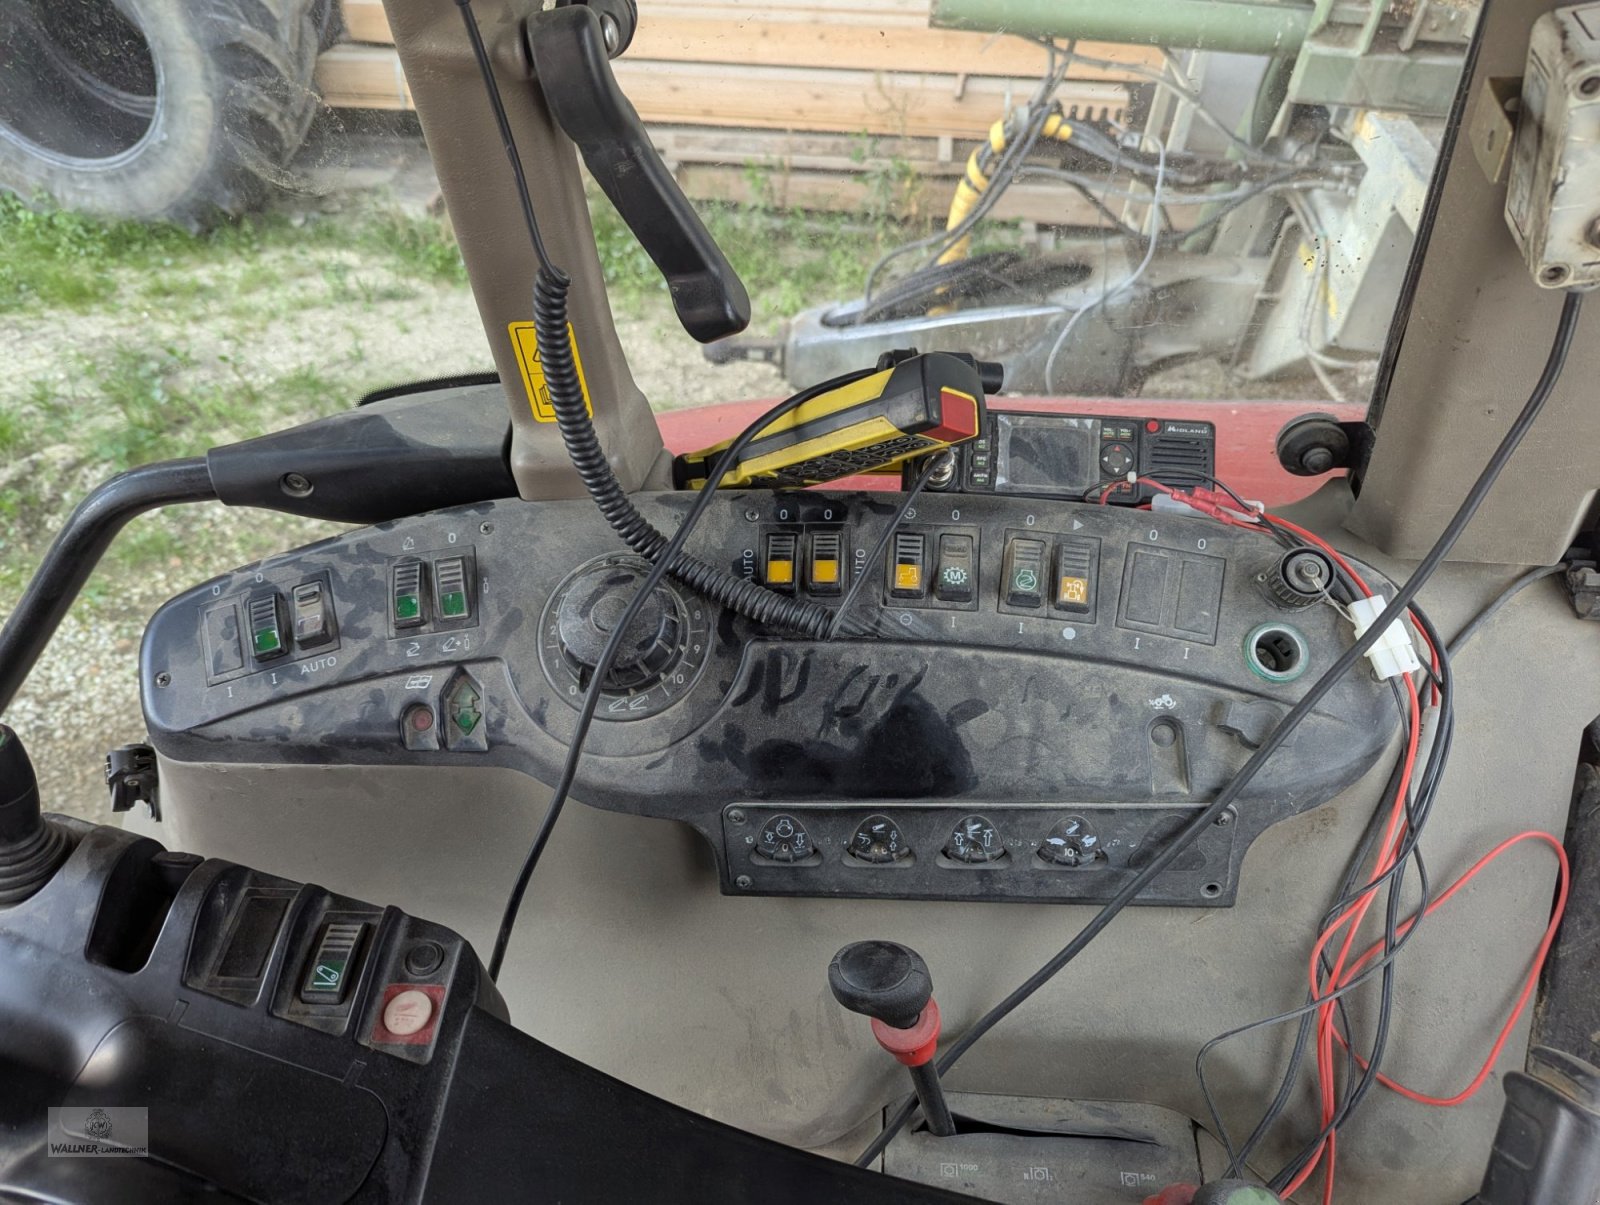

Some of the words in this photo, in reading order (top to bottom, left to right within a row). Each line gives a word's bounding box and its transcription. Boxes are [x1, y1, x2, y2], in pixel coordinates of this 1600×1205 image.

[1167, 425, 1208, 434] MIDLAND
[855, 548, 866, 576] UTO
[694, 610, 701, 620] 8
[693, 644, 700, 654] 9
[300, 656, 338, 675] AUTO
[671, 674, 684, 684] 10
[569, 685, 577, 695] 0
[1064, 847, 1074, 857] 10
